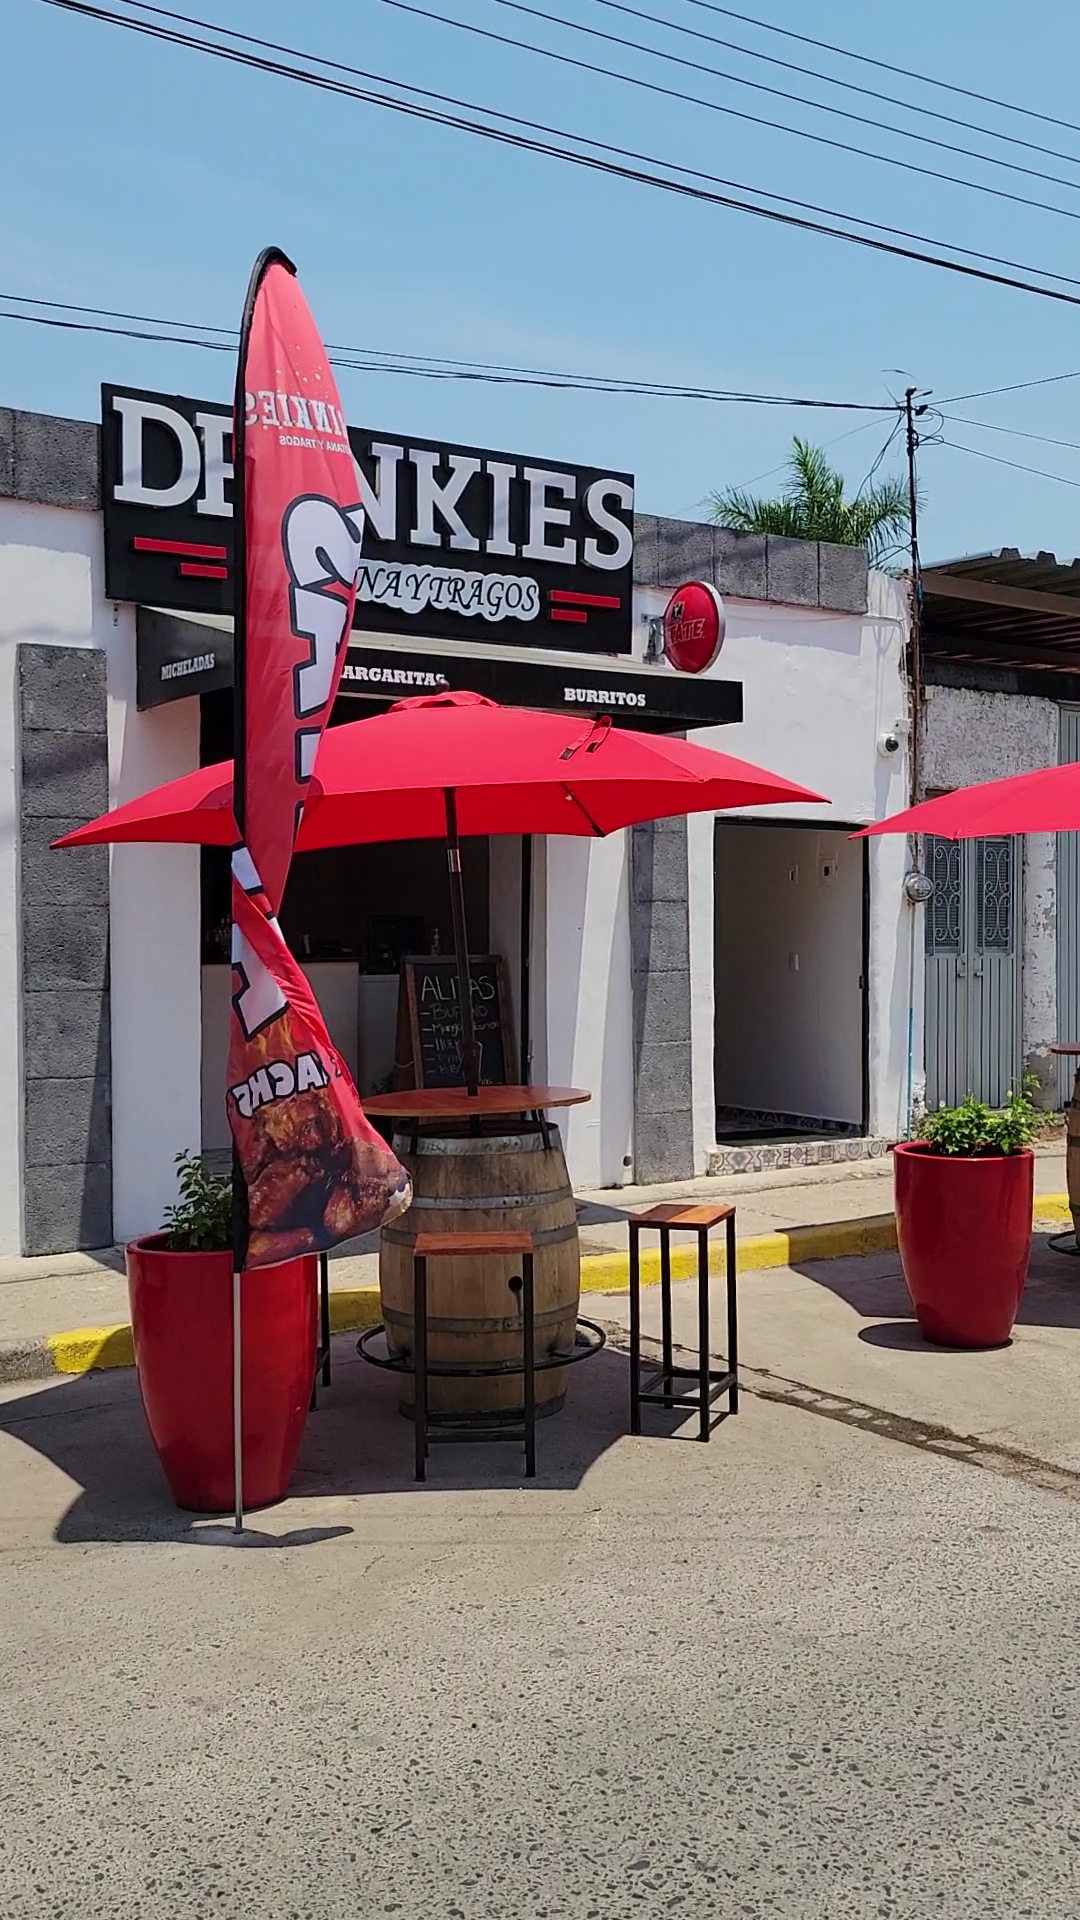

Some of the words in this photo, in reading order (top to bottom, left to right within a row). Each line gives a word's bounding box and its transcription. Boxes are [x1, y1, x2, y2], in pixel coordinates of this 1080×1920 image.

[112, 396, 635, 571] DNKIES
[161, 653, 216, 681] MICHELADAS
[341, 665, 445, 687] ARGARITAS
[564, 688, 646, 707] BURRITOS
[421, 975, 495, 1001] ALIAS
